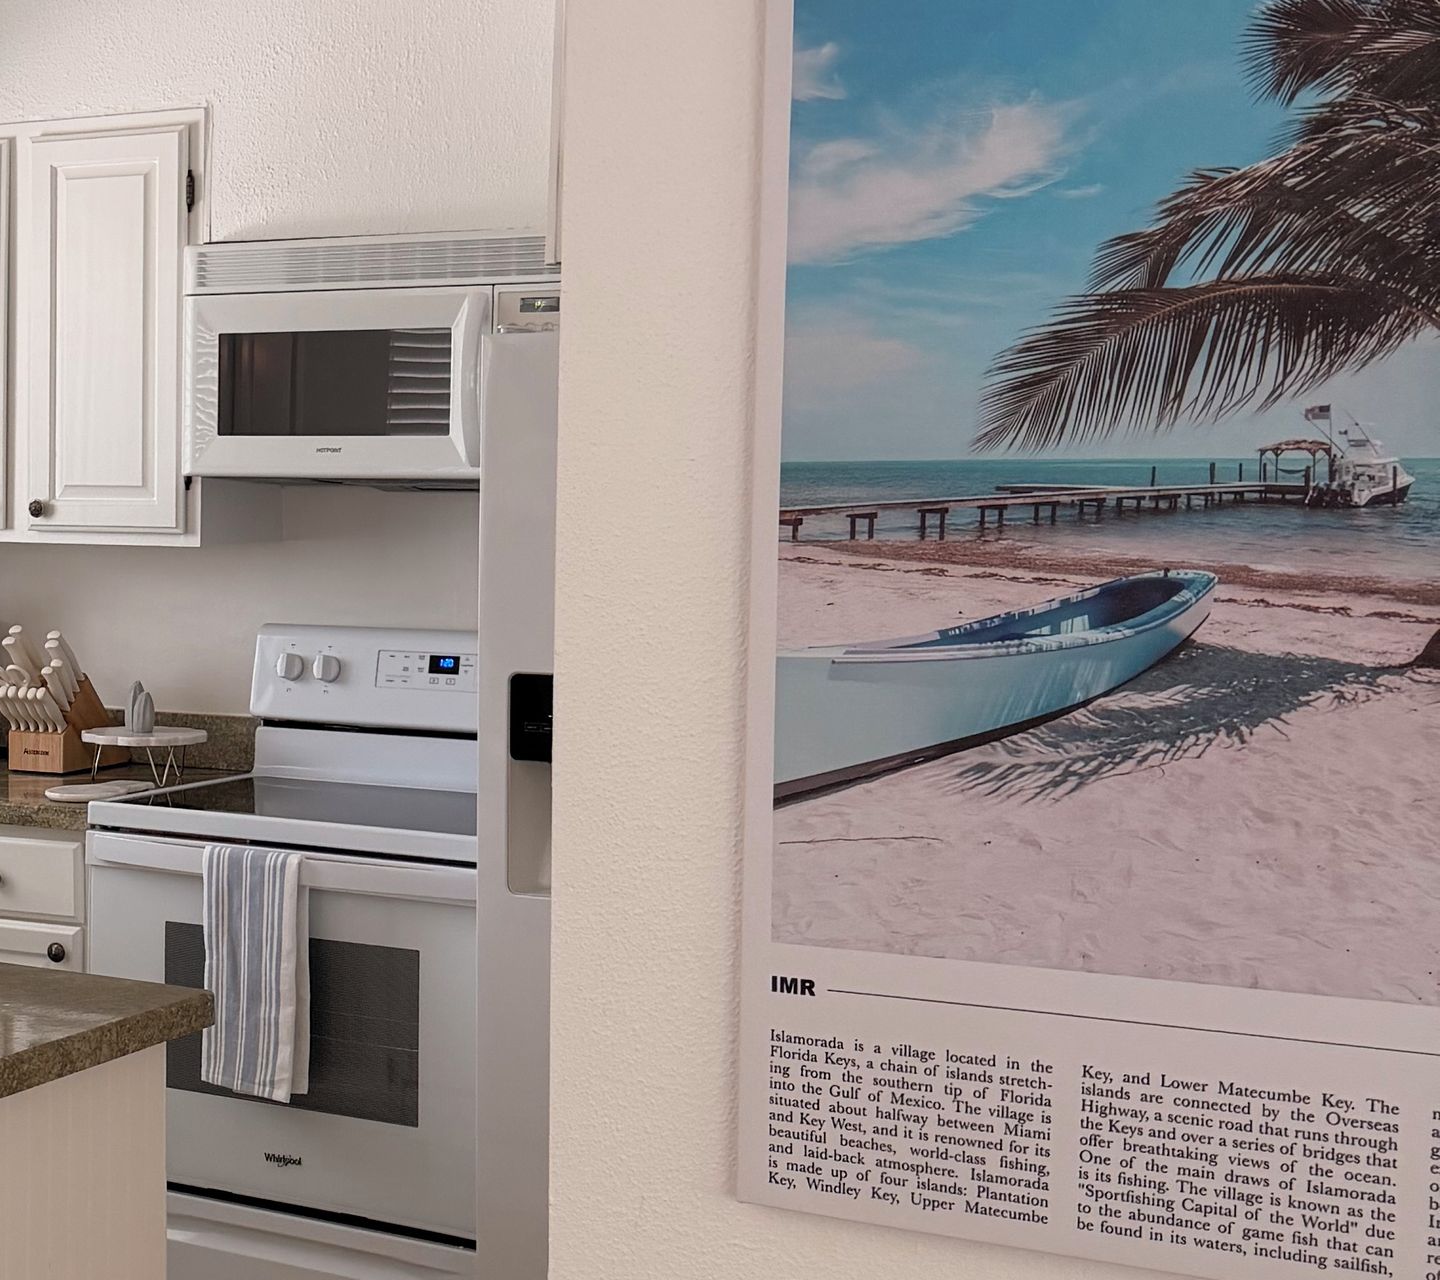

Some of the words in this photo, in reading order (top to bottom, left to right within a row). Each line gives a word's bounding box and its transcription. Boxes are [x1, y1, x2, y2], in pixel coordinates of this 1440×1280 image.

[771, 975, 816, 997] IMR
[770, 1028, 845, 1050] Islamorada
[854, 1038, 865, 1053] is
[873, 1044, 882, 1055] a
[890, 1043, 937, 1066] village
[945, 1048, 997, 1068] located
[1005, 1055, 1020, 1071] in
[1030, 1059, 1054, 1074] the
[770, 1044, 818, 1064] Florida
[824, 1051, 861, 1072] Keys,
[865, 1060, 875, 1070] a
[879, 1058, 918, 1075] chain
[923, 1064, 941, 1078] of
[945, 1065, 994, 1084] islands
[998, 1075, 1053, 1091] stretch-
[769, 1060, 791, 1079] ing
[799, 1064, 832, 1081] from
[841, 1069, 864, 1085] the
[872, 1076, 934, 1094] southern
[943, 1082, 964, 1102] tip
[972, 1086, 990, 1100] of
[1000, 1088, 1053, 1108] Florida
[769, 1076, 796, 1092] into
[801, 1081, 823, 1096] the
[828, 1084, 862, 1100] Gulf
[867, 1089, 884, 1103] of
[889, 1091, 946, 1111] Mexico.
[954, 1099, 982, 1116] The
[987, 1104, 1035, 1126] village
[1040, 1110, 1052, 1125] is
[1081, 1064, 1114, 1085] Key,
[1122, 1072, 1151, 1086] and
[1160, 1073, 1209, 1093] Lower
[1217, 1080, 1311, 1105] Matecumbe
[1321, 1092, 1356, 1114] Key.
[1365, 1097, 1400, 1116] The
[1081, 1081, 1131, 1101] islands
[1139, 1092, 1164, 1105] are
[1173, 1096, 1252, 1116] connected
[1261, 1102, 1280, 1123] by
[1290, 1107, 1316, 1124] the
[1325, 1110, 1399, 1134] Overseas
[768, 1092, 821, 1112] situated
[828, 1100, 868, 1117] about
[875, 1105, 929, 1130] halfway
[936, 1113, 995, 1134] between
[1003, 1122, 1051, 1142] Miami
[768, 1110, 794, 1124] and
[799, 1111, 827, 1133] Key
[830, 1116, 867, 1136] West,
[871, 1124, 898, 1138] and
[903, 1125, 914, 1140] it
[918, 1127, 929, 1142] is
[934, 1134, 1004, 1152] renowned
[1008, 1139, 1030, 1155] for
[1034, 1142, 1051, 1158] its
[1080, 1098, 1150, 1124] Highway,
[1153, 1111, 1164, 1122] a
[1167, 1113, 1214, 1129] scenic
[1218, 1118, 1254, 1134] road
[1258, 1121, 1290, 1138] that
[1294, 1129, 1330, 1143] runs
[1334, 1130, 1398, 1154] through
[1080, 1116, 1104, 1132] the
[1108, 1118, 1144, 1140] Keys
[1147, 1126, 1177, 1141] and
[1180, 1132, 1215, 1146] over
[1218, 1137, 1228, 1148] a
[1231, 1137, 1275, 1154] series
[1279, 1141, 1298, 1156] of
[1302, 1143, 1361, 1167] bridges
[1365, 1152, 1398, 1170] that
[264, 1152, 302, 1168] Whirlpool
[768, 1123, 827, 1145] beautiful
[839, 1133, 897, 1156] beaches,
[909, 1146, 987, 1166] world-class
[999, 1155, 1051, 1179] fishing,
[768, 1142, 794, 1156] and
[803, 1144, 866, 1166] laid-back
[875, 1158, 959, 1183] atmosphere.
[970, 1167, 1050, 1192] Islamorada
[1078, 1149, 1112, 1167] One
[1119, 1155, 1137, 1170] of
[1145, 1158, 1169, 1174] the
[1176, 1165, 1215, 1181] main
[1224, 1168, 1270, 1188] draws
[1278, 1177, 1297, 1191] of
[1306, 1179, 1397, 1205] Islamorada
[1079, 1133, 1114, 1150] offer
[1122, 1137, 1220, 1168] breathtaking
[1228, 1152, 1271, 1170] views
[1279, 1159, 1299, 1174] of
[1308, 1162, 1334, 1179] the
[1343, 1170, 1397, 1187] ocean.
[768, 1155, 779, 1169] is
[786, 1161, 823, 1176] made
[830, 1168, 849, 1184] up
[855, 1169, 872, 1182] of
[879, 1171, 910, 1188] four
[916, 1176, 968, 1197] islands:
[976, 1184, 1049, 1209] Plantation
[768, 1171, 797, 1191] Key,
[806, 1176, 862, 1200] Windley
[870, 1186, 900, 1206] Key,
[910, 1191, 956, 1212] Upper
[964, 1199, 1049, 1225] Matecumbe
[1078, 1166, 1090, 1181] is
[1094, 1168, 1112, 1184] its
[1117, 1171, 1170, 1195] fishing.
[1178, 1179, 1208, 1197] The
[1213, 1185, 1264, 1209] village
[1269, 1191, 1282, 1207] is
[1287, 1194, 1341, 1216] known
[1346, 1207, 1364, 1219] as
[1370, 1206, 1396, 1223] the
[1077, 1183, 1176, 1215] "Sportfishing
[1181, 1197, 1238, 1223] Capital
[1244, 1207, 1263, 1222] of
[1269, 1210, 1294, 1227] the
[1301, 1213, 1359, 1234] World"
[1364, 1223, 1396, 1241] due
[1077, 1202, 1092, 1215] to
[1098, 1203, 1122, 1219] the
[1127, 1208, 1211, 1232] abundance
[1217, 1221, 1236, 1235] of
[1241, 1227, 1285, 1247] game
[1291, 1230, 1319, 1248] fish
[1326, 1235, 1359, 1254] that
[1365, 1245, 1394, 1259] can
[1076, 1216, 1095, 1232] be
[1100, 1220, 1143, 1239] found
[1149, 1227, 1164, 1242] in
[1169, 1230, 1187, 1246] its
[1193, 1237, 1247, 1257] waters,
[1253, 1242, 1328, 1271] including
[1333, 1256, 1393, 1279] sailfish,
